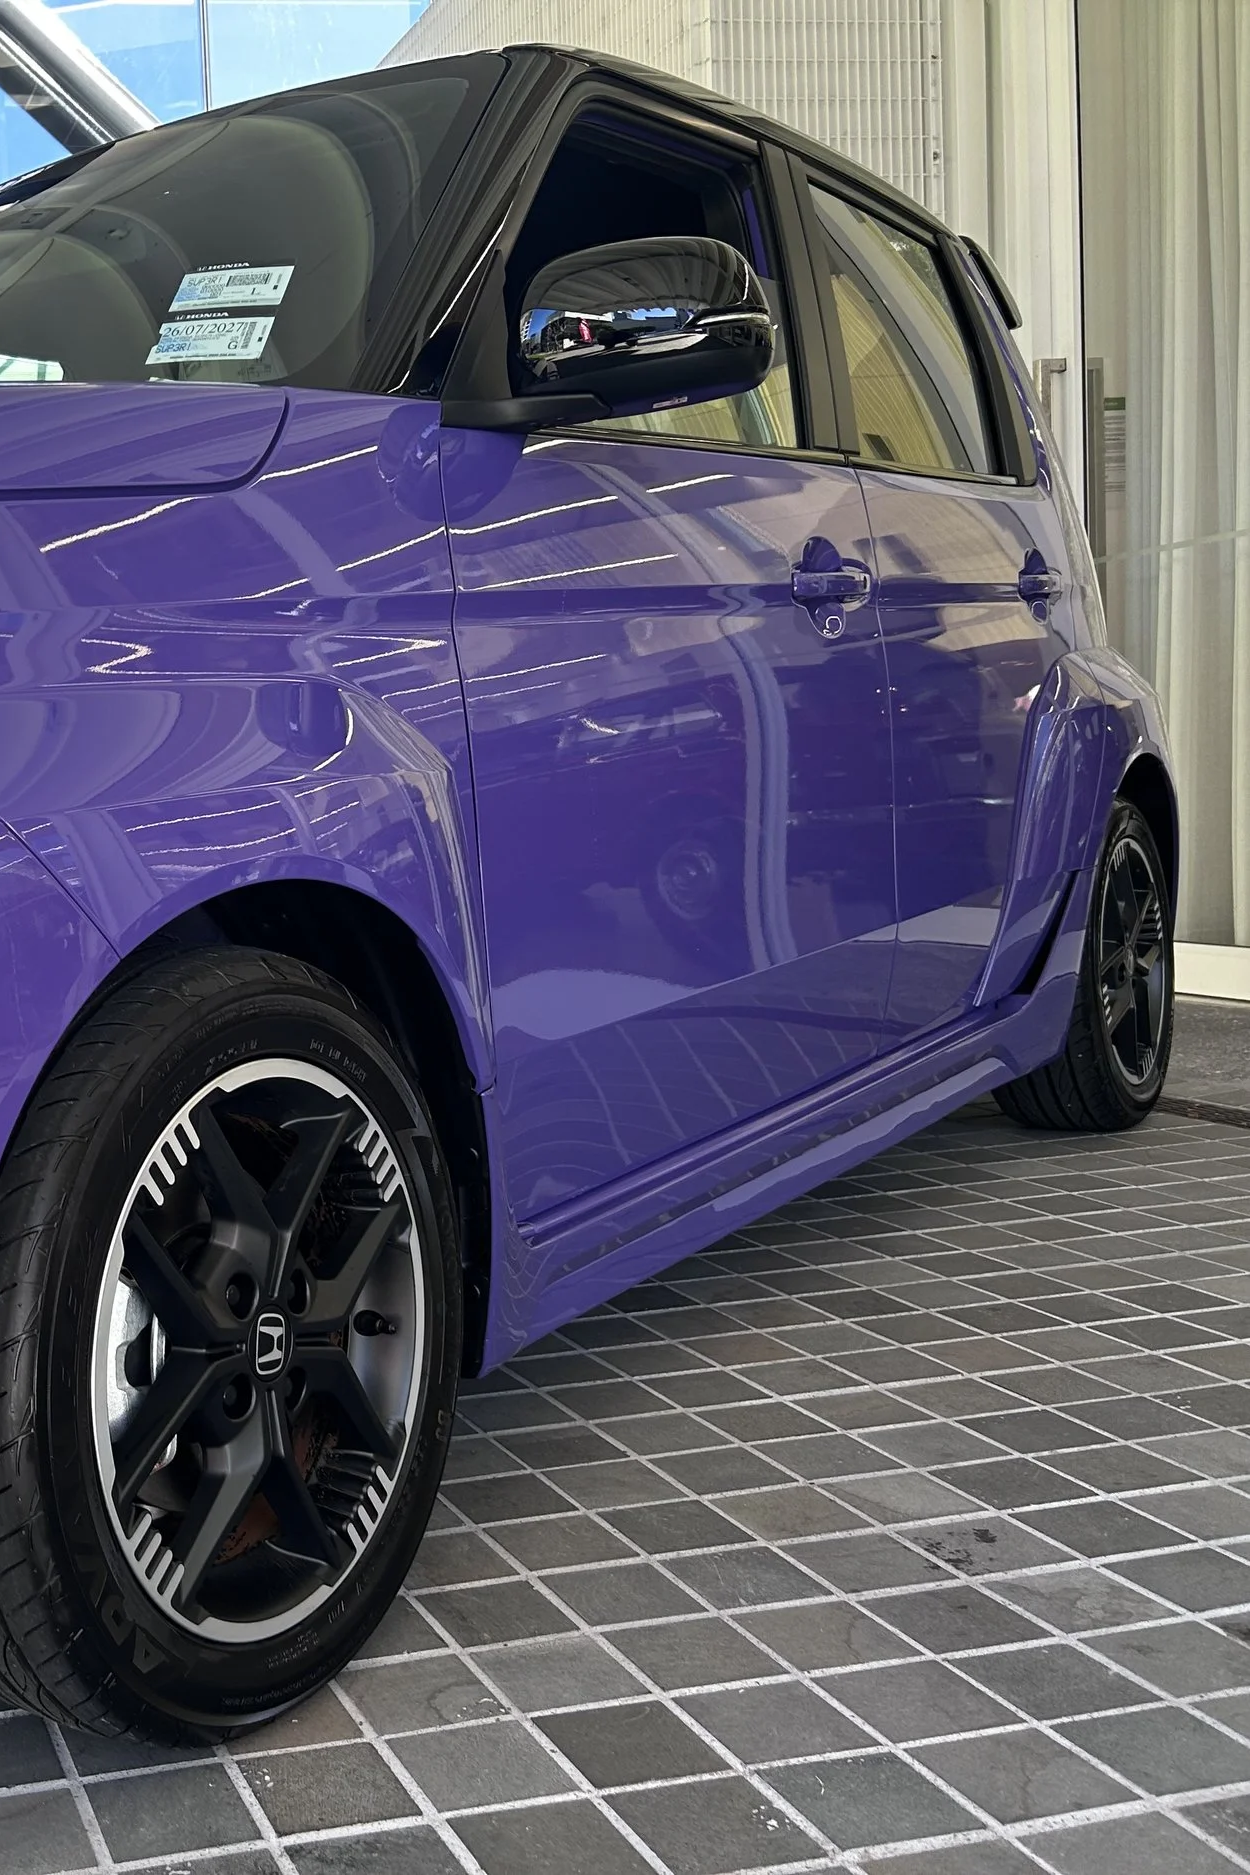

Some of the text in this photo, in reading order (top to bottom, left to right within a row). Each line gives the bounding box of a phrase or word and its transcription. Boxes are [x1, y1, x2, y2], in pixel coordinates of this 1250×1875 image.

[207, 262, 250, 271] HONDA
[186, 311, 229, 320] HONDA
[163, 322, 245, 337] 26/07/2027
[227, 341, 238, 350] G
